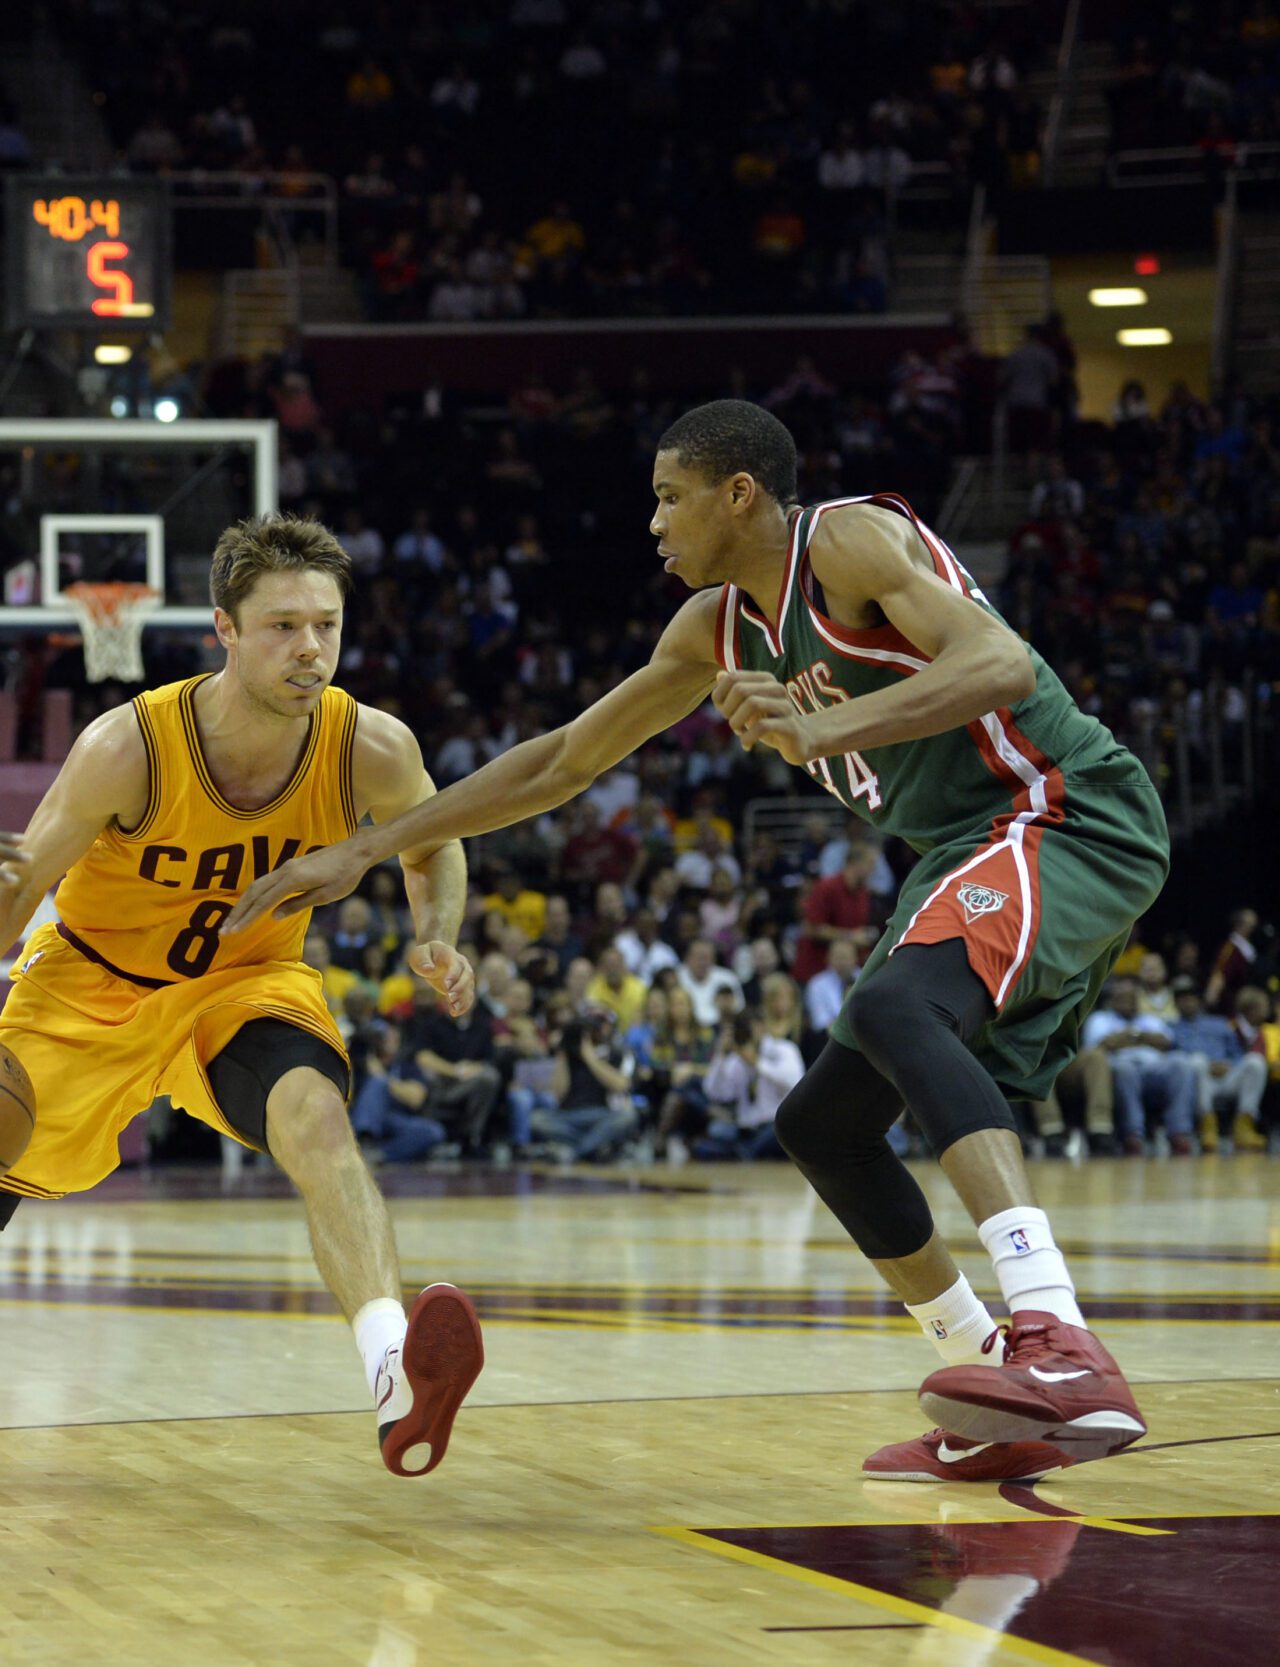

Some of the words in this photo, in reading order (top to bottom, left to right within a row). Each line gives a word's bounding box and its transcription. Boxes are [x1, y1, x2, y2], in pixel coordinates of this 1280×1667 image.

[32, 196, 120, 241] 40.4
[87, 241, 133, 317] 5
[138, 835, 329, 891] CAV
[166, 900, 235, 978] 8
